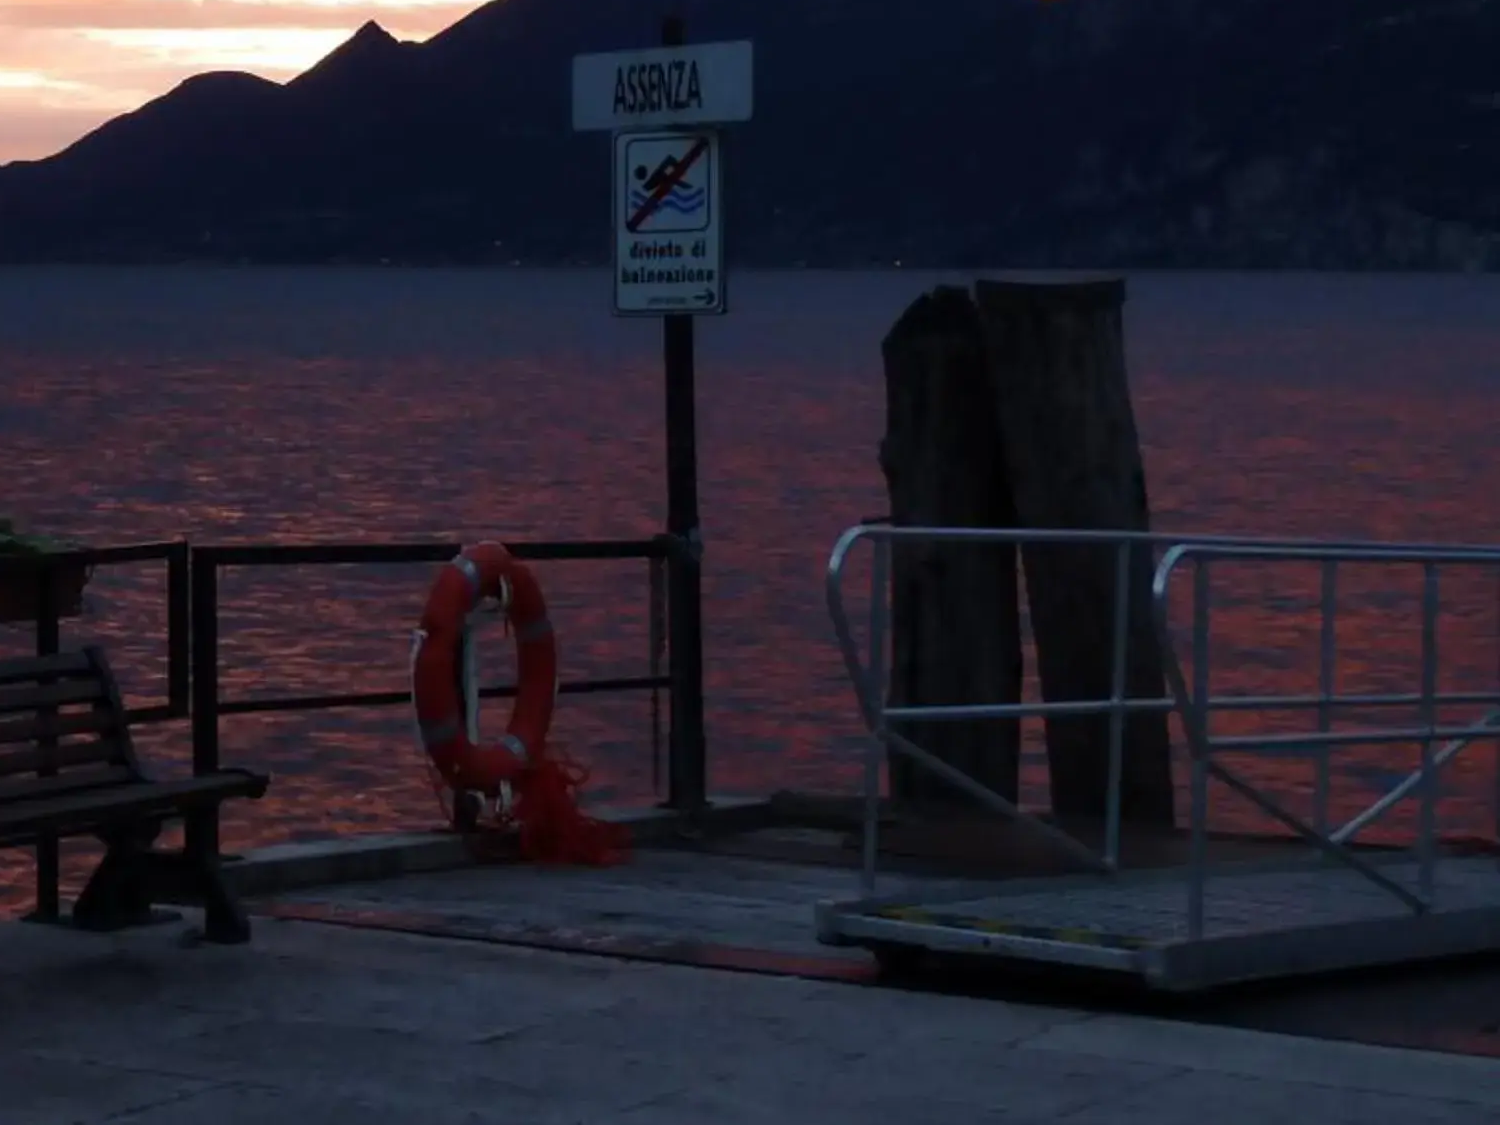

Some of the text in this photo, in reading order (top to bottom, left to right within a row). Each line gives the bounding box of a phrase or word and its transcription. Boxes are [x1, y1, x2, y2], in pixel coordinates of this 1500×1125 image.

[613, 59, 702, 114] ASSENZA
[630, 240, 706, 259] divieto di
[621, 265, 714, 284] balneazione
